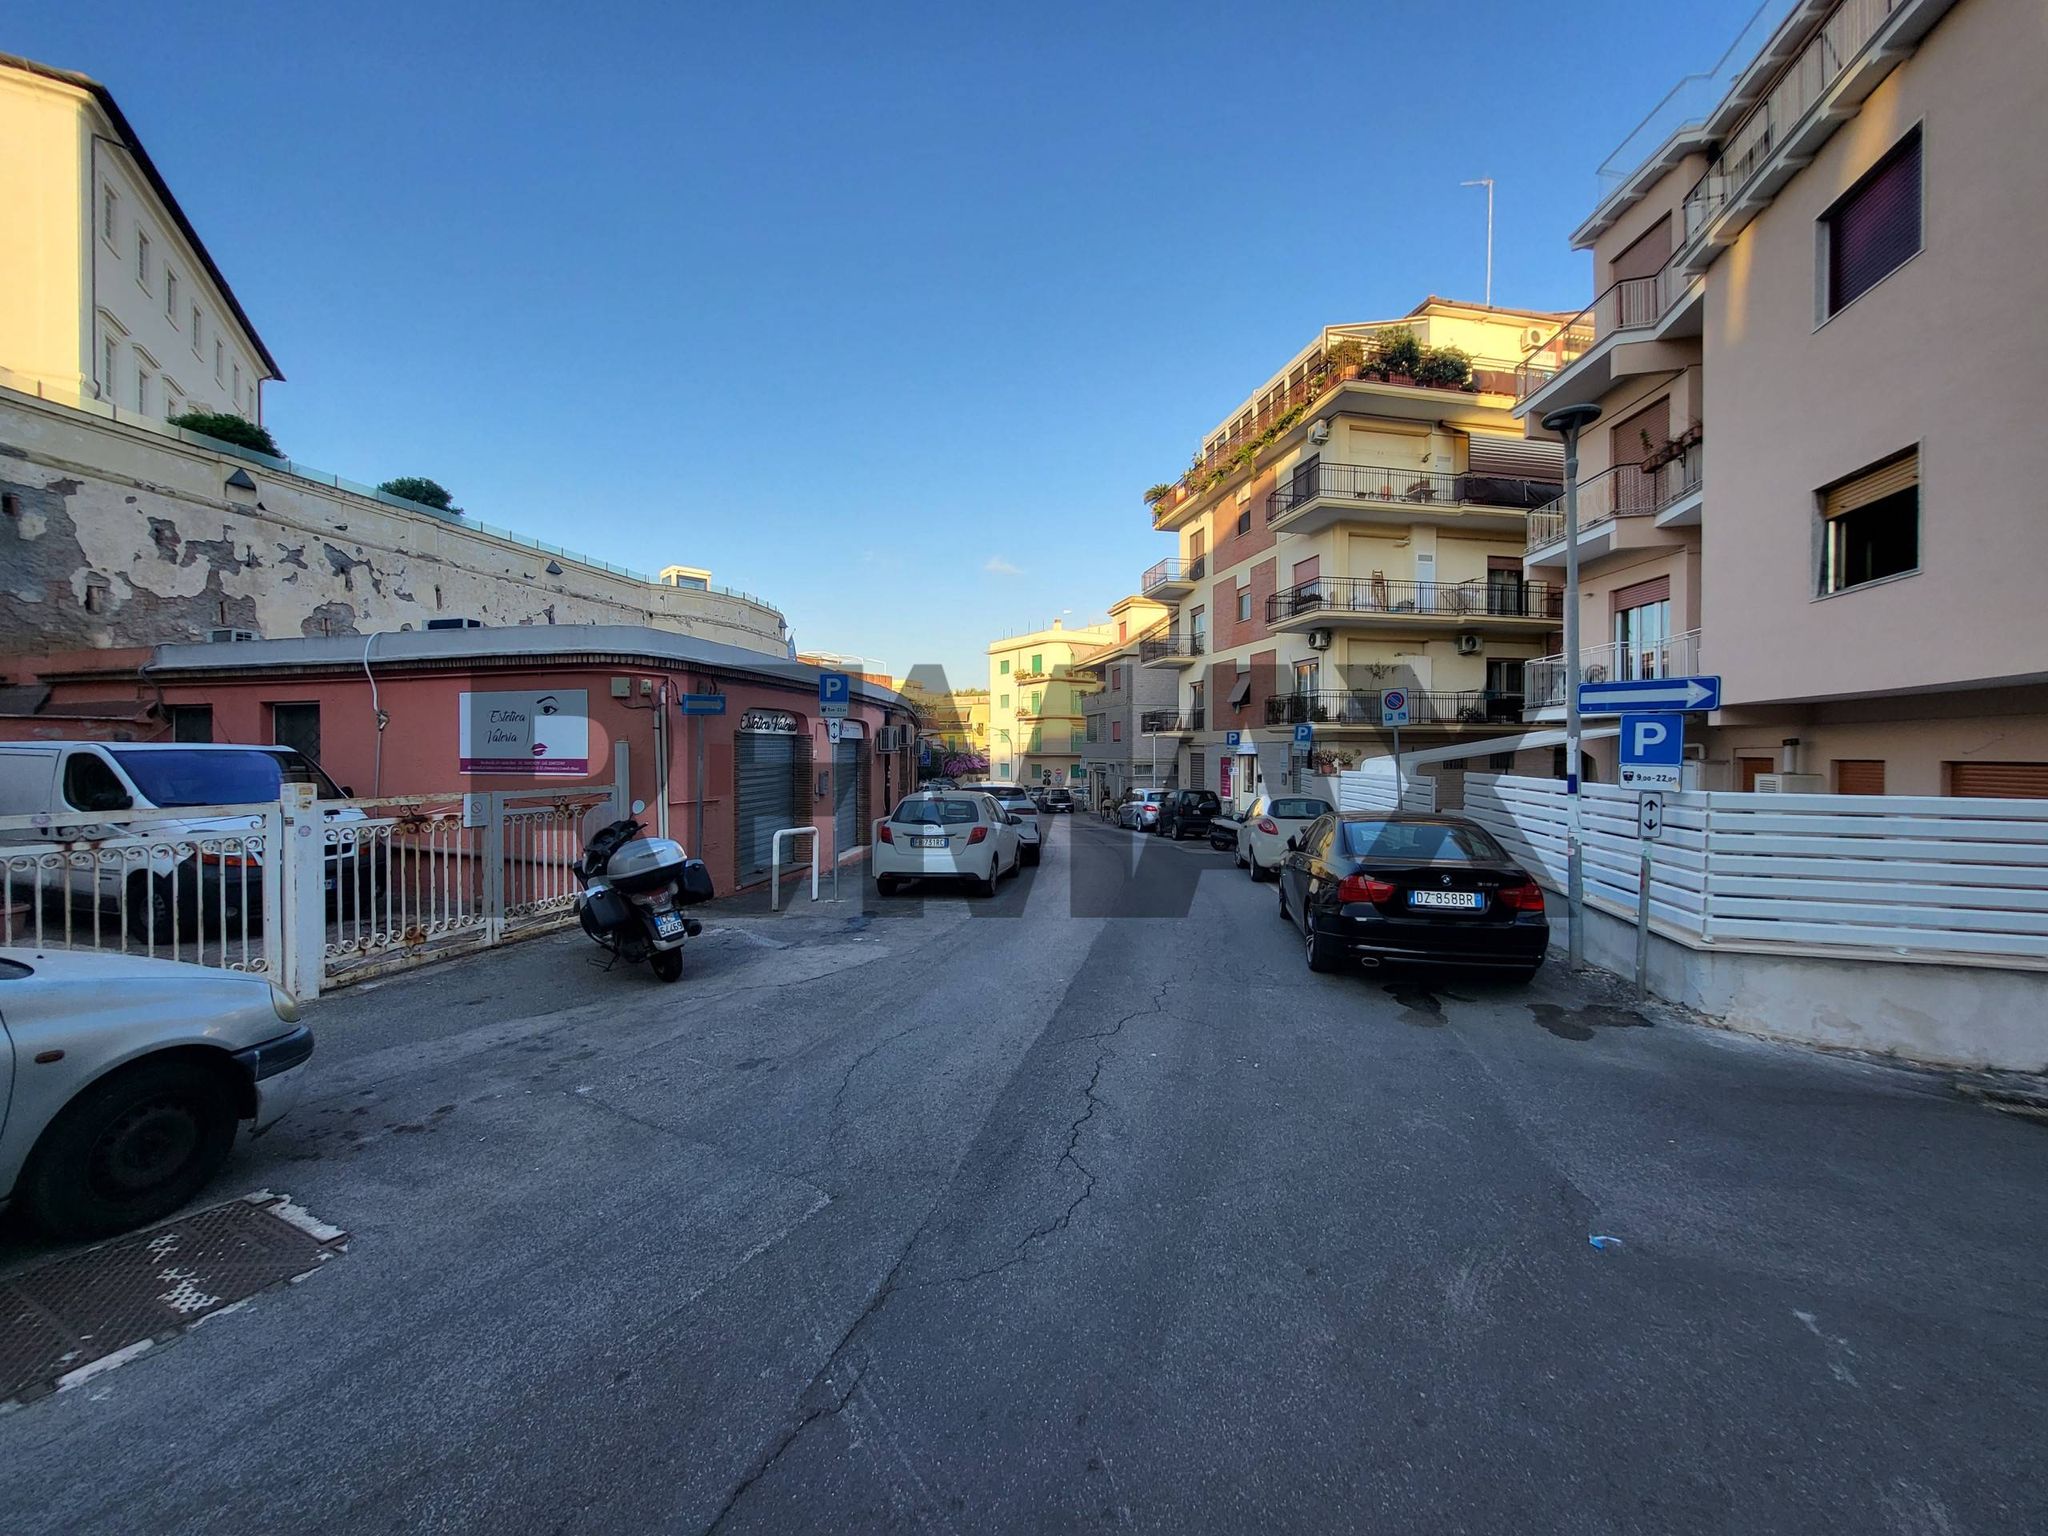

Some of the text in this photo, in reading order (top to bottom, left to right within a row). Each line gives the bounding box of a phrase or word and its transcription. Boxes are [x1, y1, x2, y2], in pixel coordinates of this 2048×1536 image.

[826, 677, 842, 698] P
[490, 710, 525, 723] Estetica
[487, 728, 517, 744] Valeria
[1228, 733, 1238, 745] P
[1297, 726, 1309, 740] P
[1634, 722, 1667, 756] P
